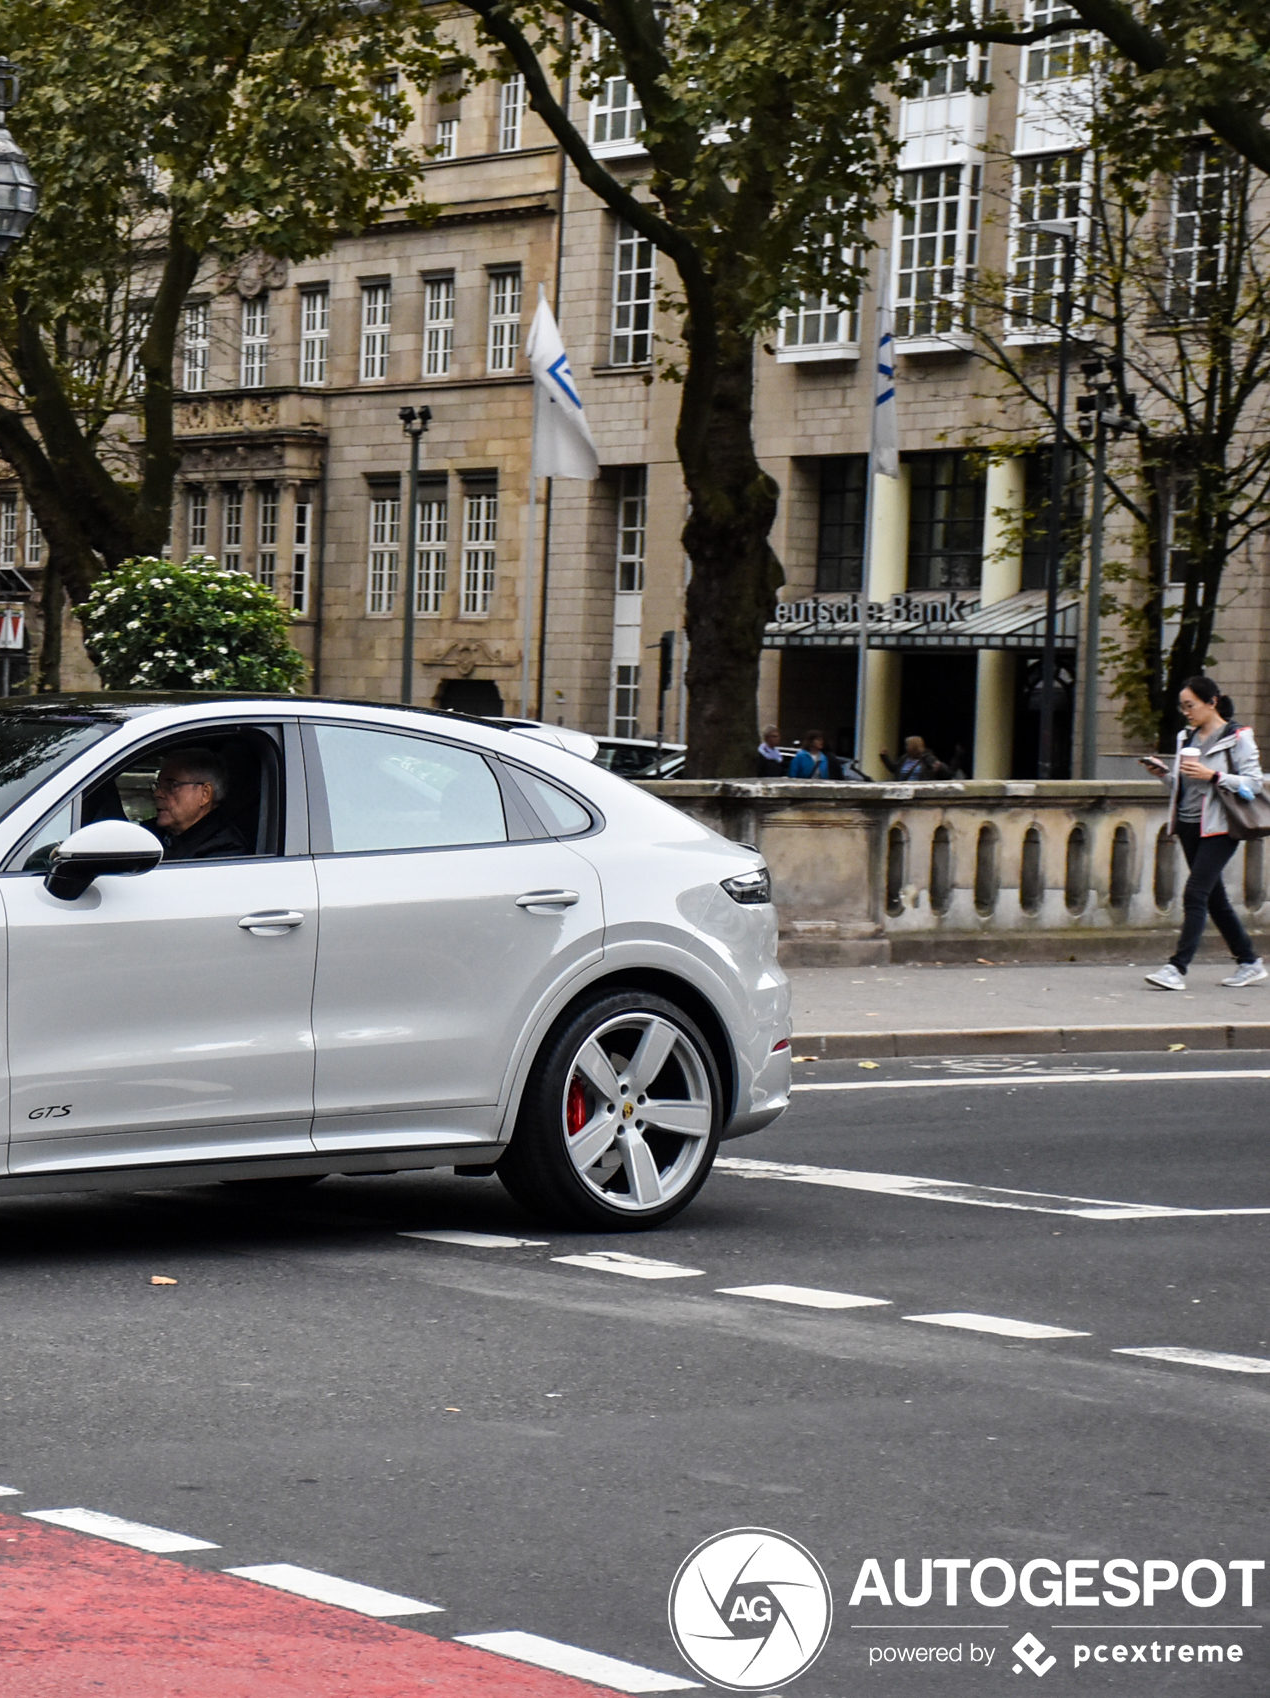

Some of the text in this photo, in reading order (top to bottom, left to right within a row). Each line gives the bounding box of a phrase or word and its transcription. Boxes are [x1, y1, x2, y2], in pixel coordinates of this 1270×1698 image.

[775, 592, 962, 623] eutsche Bank
[28, 1104, 73, 1120] GTS
